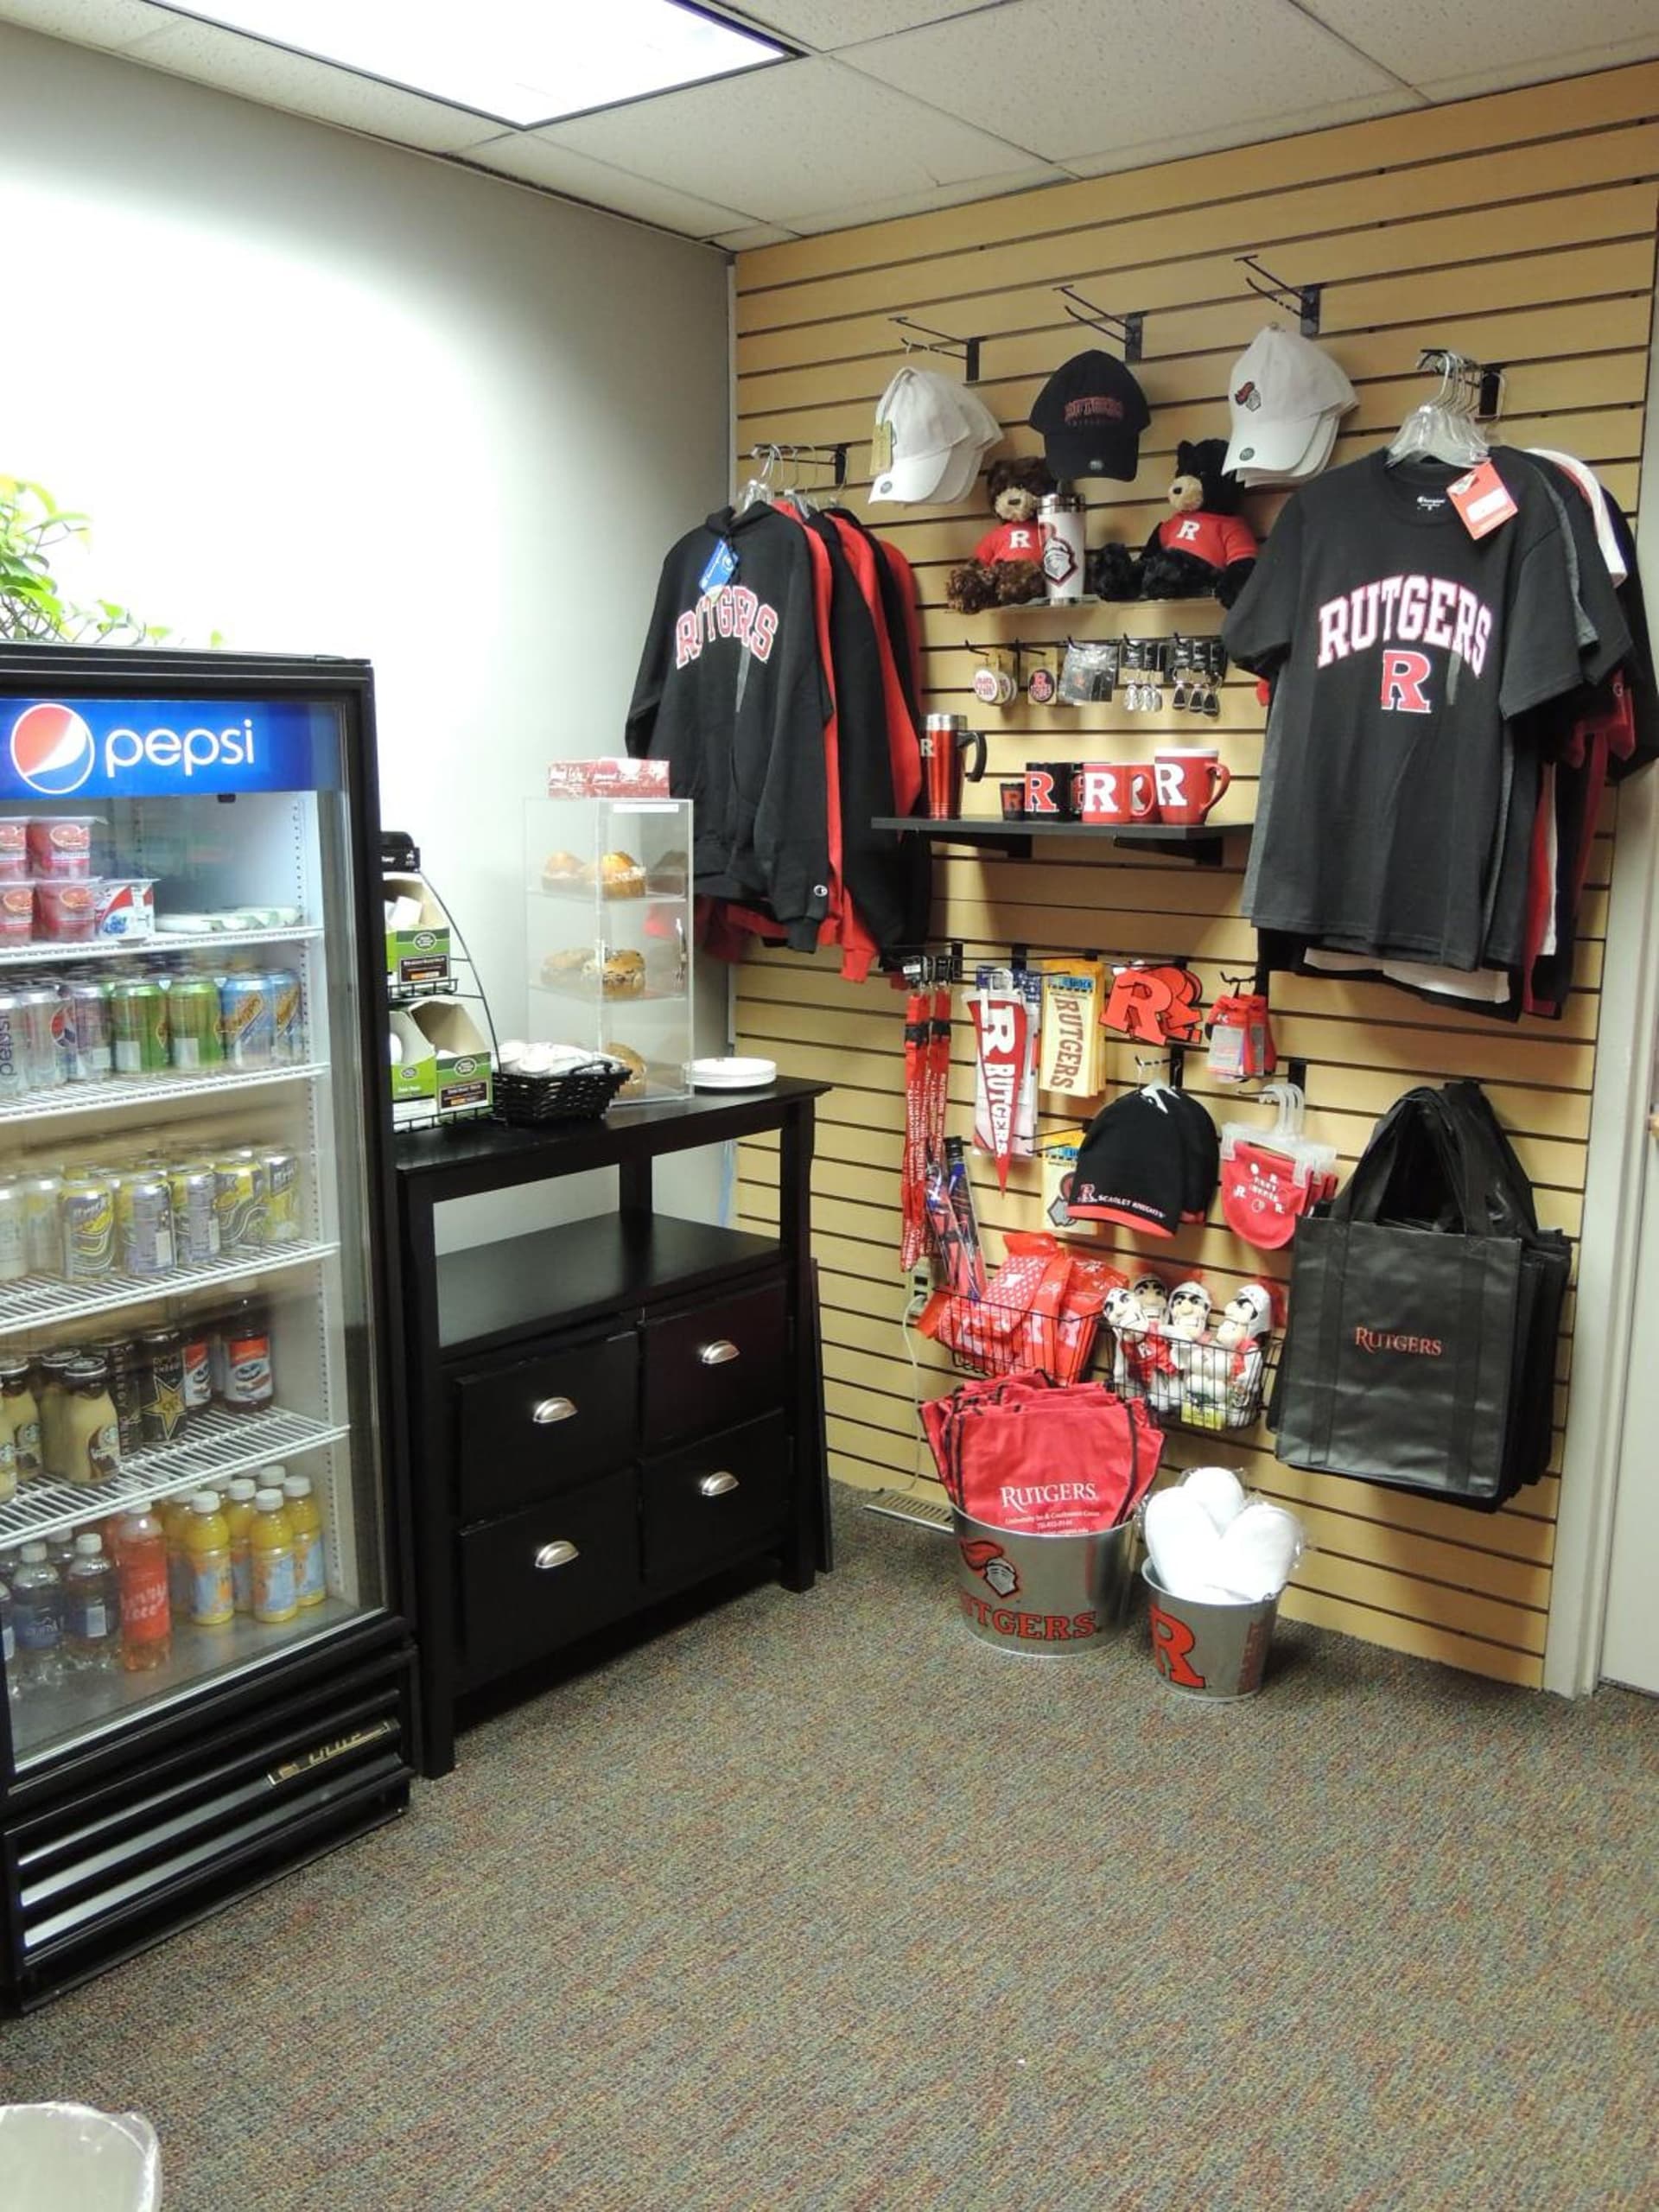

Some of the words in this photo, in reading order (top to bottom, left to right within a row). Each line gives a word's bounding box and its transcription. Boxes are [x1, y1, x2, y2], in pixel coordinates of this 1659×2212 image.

[1009, 530, 1031, 550] R
[1176, 520, 1200, 541] R
[1318, 575, 1492, 679] RUTGERS
[1380, 649, 1432, 714] R
[105, 718, 255, 778] pepsi
[920, 738, 934, 757] R
[1025, 771, 1059, 812] R
[1084, 772, 1120, 814] R
[1155, 763, 1187, 806] R
[1049, 997, 1083, 1090] RUTGERS
[1355, 1326, 1443, 1356] RUTGERS
[1000, 1483, 1099, 1514] RUTGERS
[960, 1591, 1097, 1641] TGERS
[1149, 1604, 1206, 1689] R
